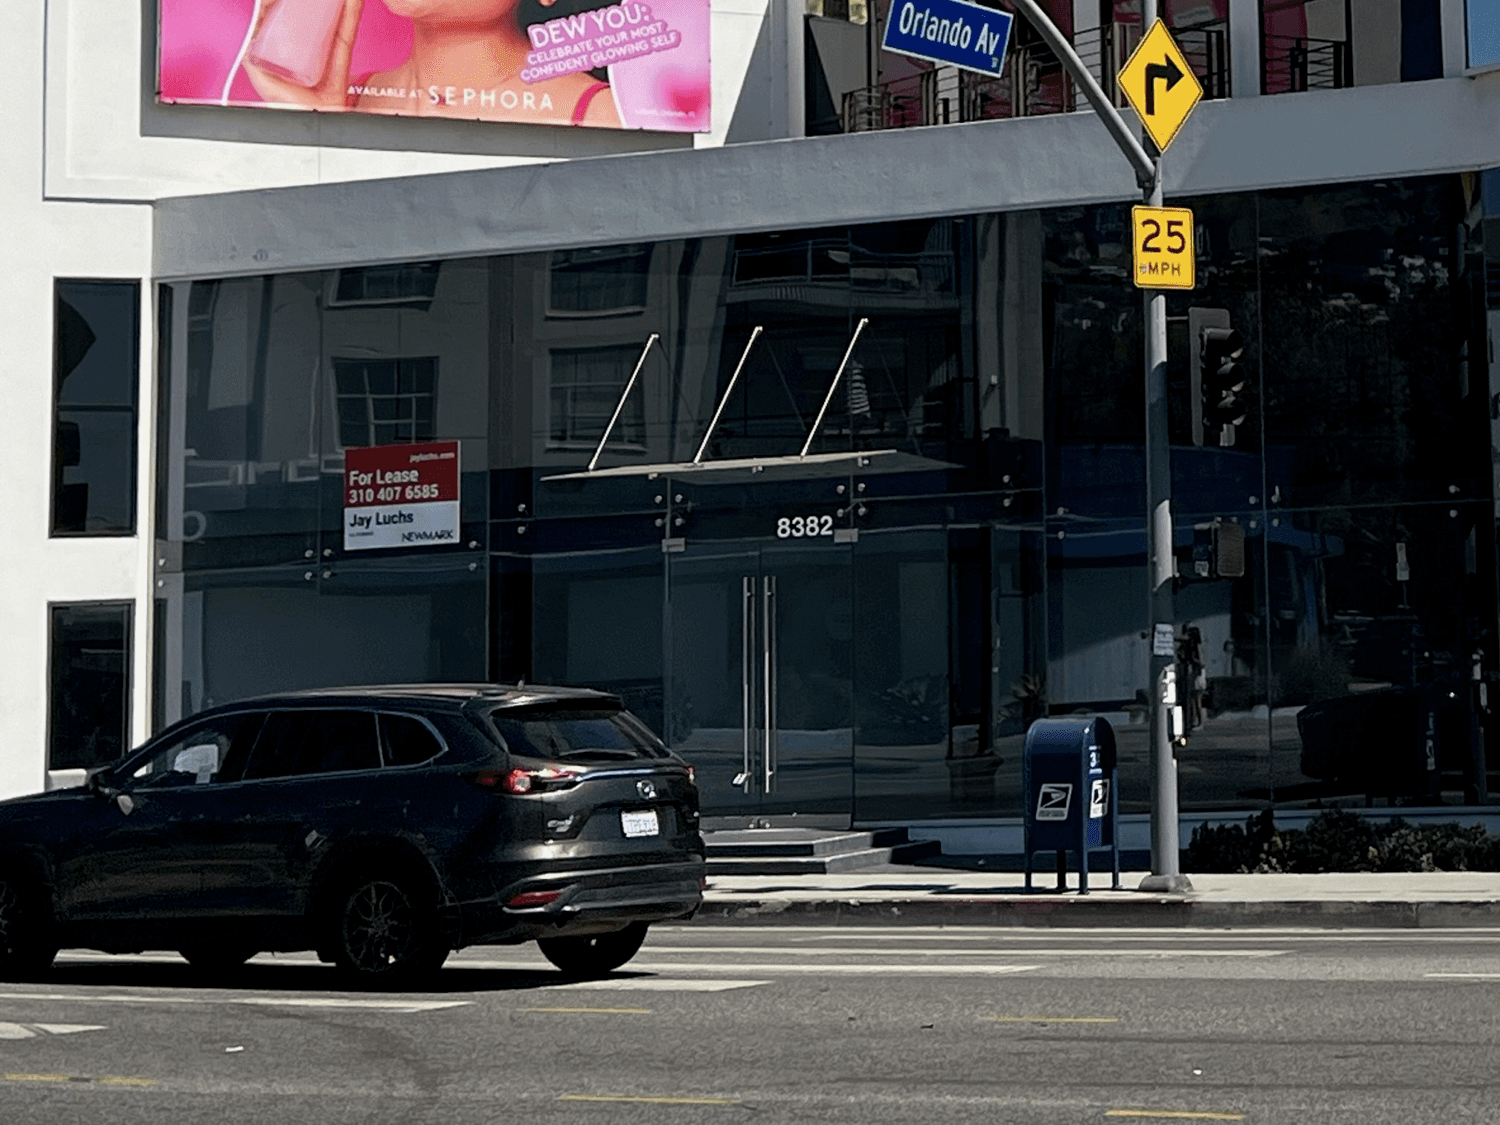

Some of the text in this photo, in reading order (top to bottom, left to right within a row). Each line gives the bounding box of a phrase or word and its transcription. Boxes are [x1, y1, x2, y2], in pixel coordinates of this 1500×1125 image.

[531, 3, 650, 48] DEW YOU:
[899, 2, 1001, 56] Orlando Av
[528, 22, 663, 65] CELEBRATE YOUR MOST
[520, 32, 677, 81] CONFIDENT GLOWING SELF
[347, 85, 554, 111] AVAILABLE AT SEPHORA
[1141, 218, 1186, 254] 25
[1149, 261, 1181, 277] MPH
[349, 468, 419, 486] For Lease
[349, 483, 439, 503] 310 407 6585
[349, 510, 414, 529] Jay Luchs
[777, 515, 833, 538] 8382
[401, 529, 453, 542] NEWMARK
